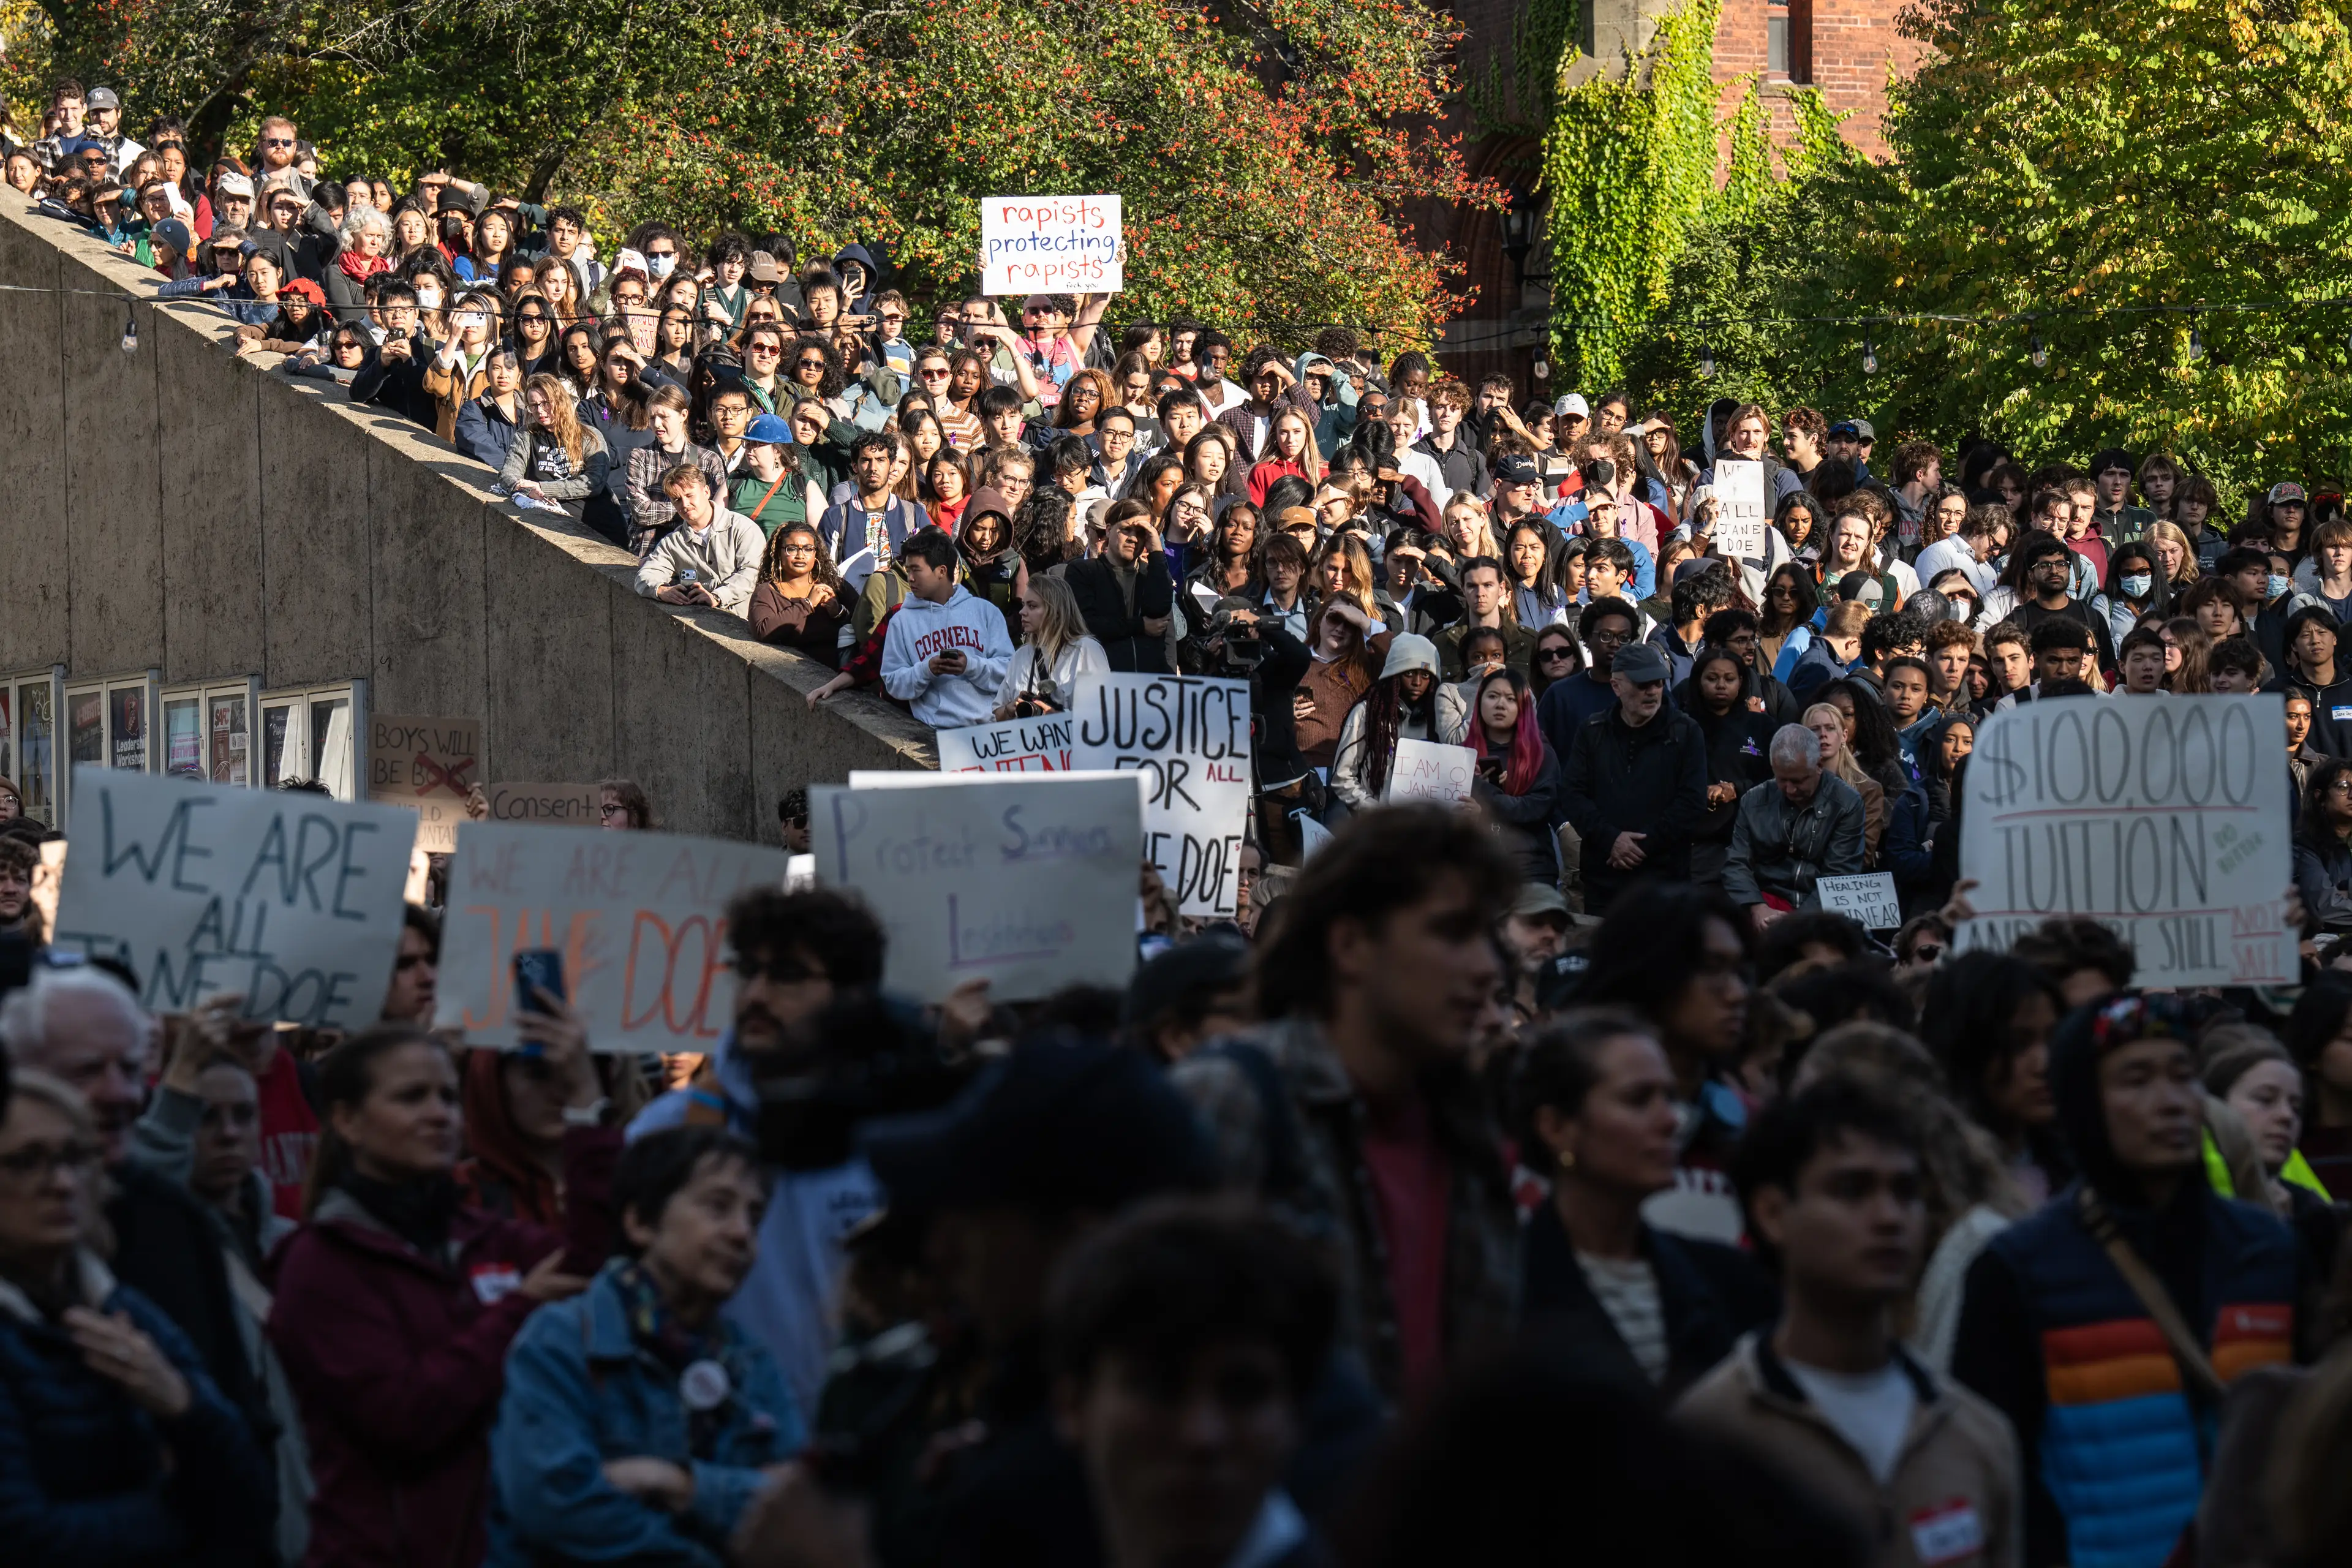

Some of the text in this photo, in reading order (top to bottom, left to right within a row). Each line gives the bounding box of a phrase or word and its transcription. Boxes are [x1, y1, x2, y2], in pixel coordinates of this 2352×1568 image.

[1003, 199, 1105, 231] rapists
[989, 229, 1115, 263] protecting
[1008, 254, 1103, 285] rapists
[634, 328, 656, 350] GREE
[1720, 502, 1758, 519] ALL
[1720, 523, 1761, 535] JANE
[1728, 538, 1754, 551] DOE
[914, 625, 984, 662] CORNELL
[1081, 677, 1248, 761] JUSTICE
[116, 736, 145, 753] Leadershi
[301, 748, 306, 760] 12
[375, 723, 474, 756] BOYS WILL
[971, 719, 1073, 760] WE WAN
[1393, 755, 1439, 780] I AM
[1978, 702, 2256, 810] $100,000
[374, 758, 467, 788] BE BOYS
[1206, 763, 1245, 783] ALL
[494, 789, 595, 820] Consent
[1401, 780, 1440, 800] JANE
[100, 786, 380, 922] WE ARE
[467, 840, 526, 897] WE
[562, 842, 637, 899] ARE
[1993, 812, 2209, 916] TUITION
[1177, 833, 1242, 913] DOE
[1823, 880, 1882, 892] HEALING
[1832, 892, 1883, 907] IS NOT
[1845, 902, 1902, 927] INEAR
[184, 894, 276, 958] ALL
[620, 908, 732, 1038] DOE
[243, 959, 358, 1028] DOE
